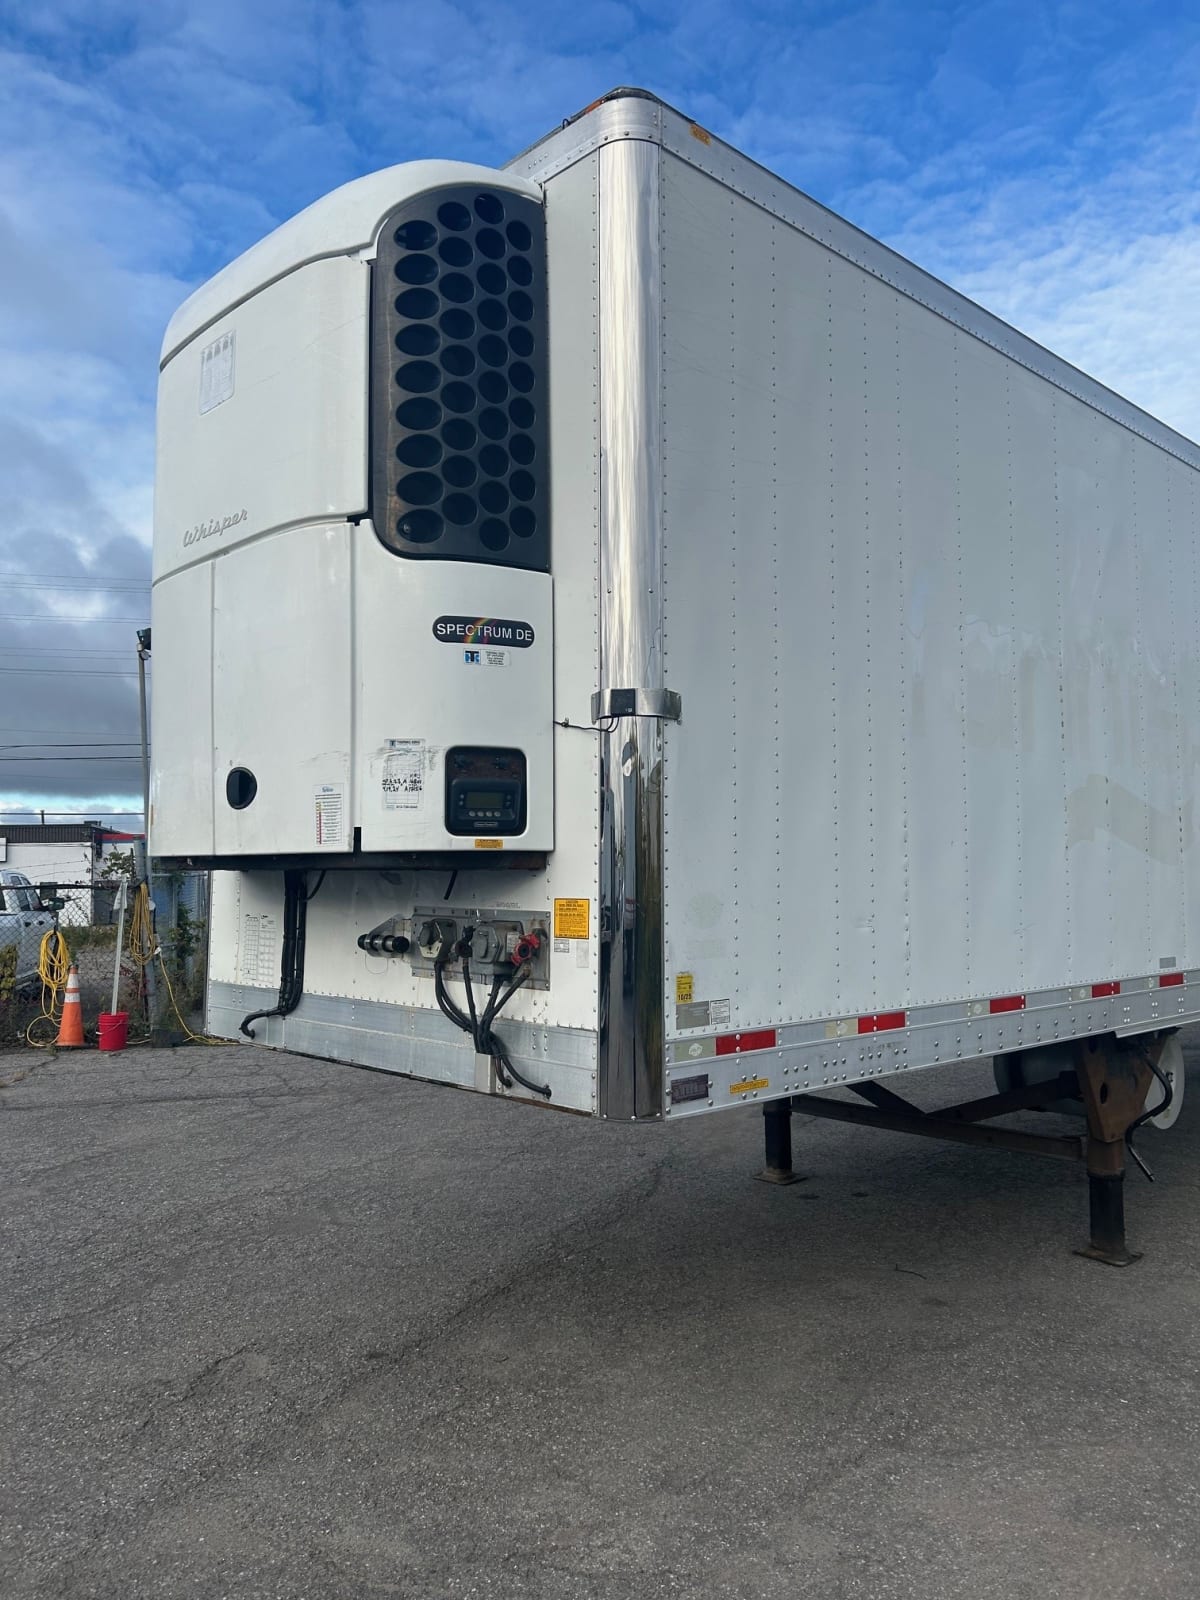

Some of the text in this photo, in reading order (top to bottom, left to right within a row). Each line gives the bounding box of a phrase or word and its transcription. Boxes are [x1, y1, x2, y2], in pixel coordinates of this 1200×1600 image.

[183, 508, 248, 548] Whisper
[436, 623, 533, 641] SPECTRUM DE
